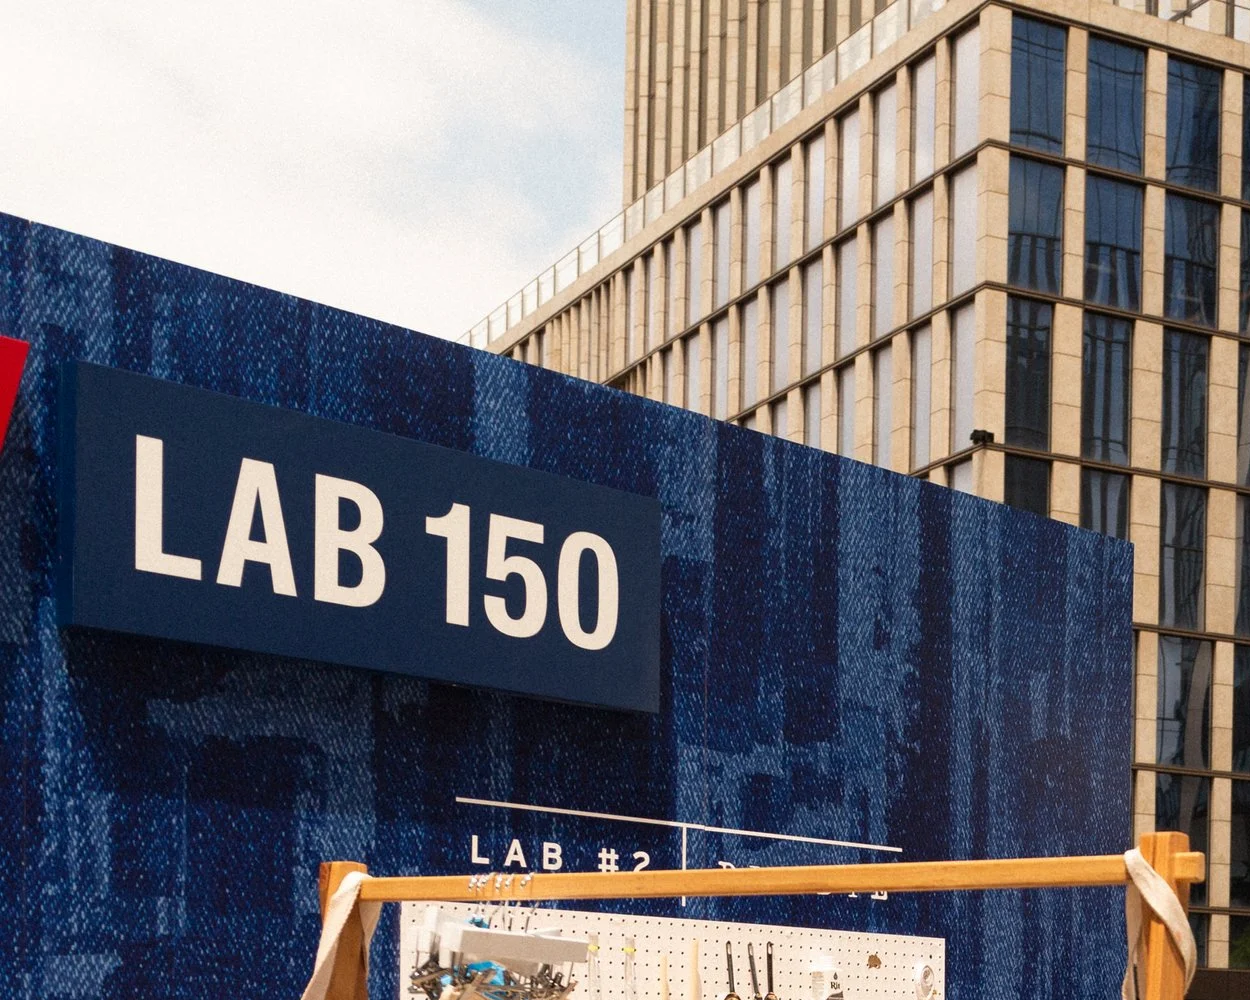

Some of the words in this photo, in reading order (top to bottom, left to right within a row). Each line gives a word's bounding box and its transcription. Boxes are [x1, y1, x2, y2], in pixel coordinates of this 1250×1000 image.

[135, 434, 387, 609] LAB
[425, 502, 620, 651] 150
[471, 834, 563, 872] LAB
